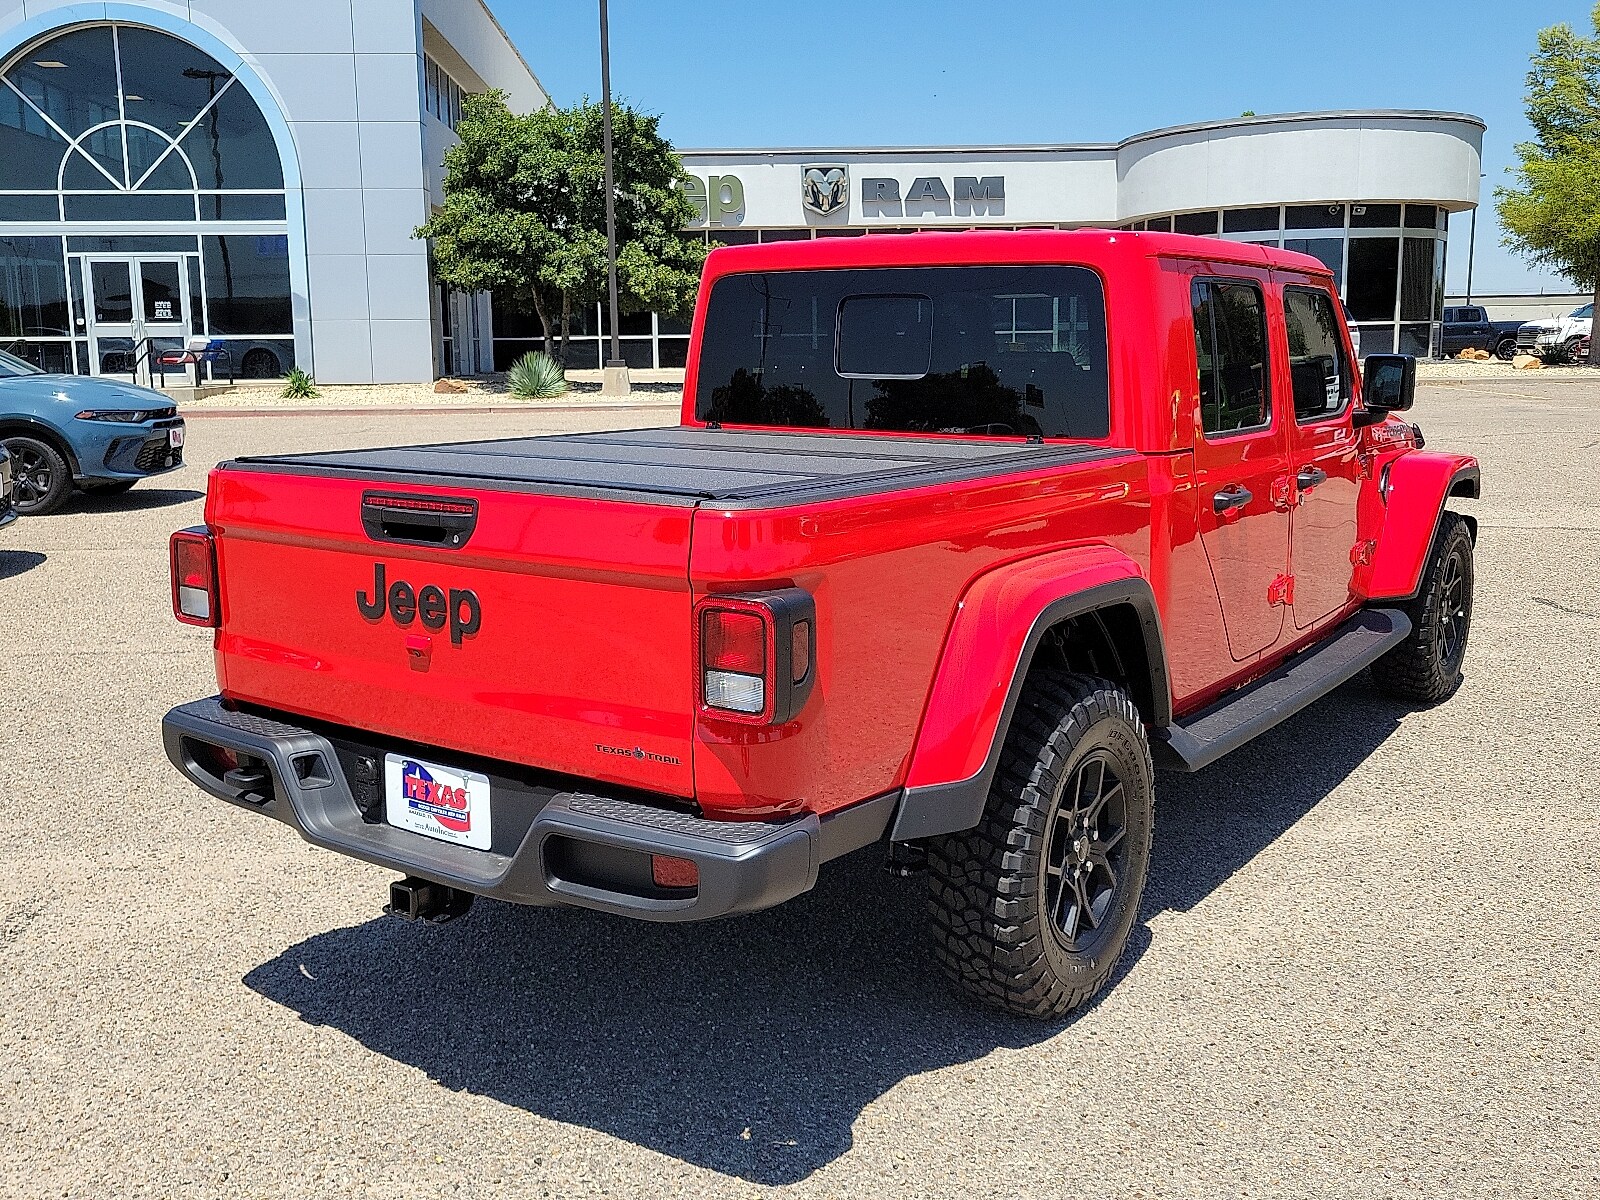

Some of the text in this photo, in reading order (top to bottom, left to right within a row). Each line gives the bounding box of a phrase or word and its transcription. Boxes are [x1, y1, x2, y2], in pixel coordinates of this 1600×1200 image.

[675, 175, 744, 223] ep
[861, 176, 1005, 205] RAM
[356, 563, 482, 645] Jeep
[595, 744, 682, 765] TEXAS TRAIL
[405, 775, 467, 811] TEXAS
